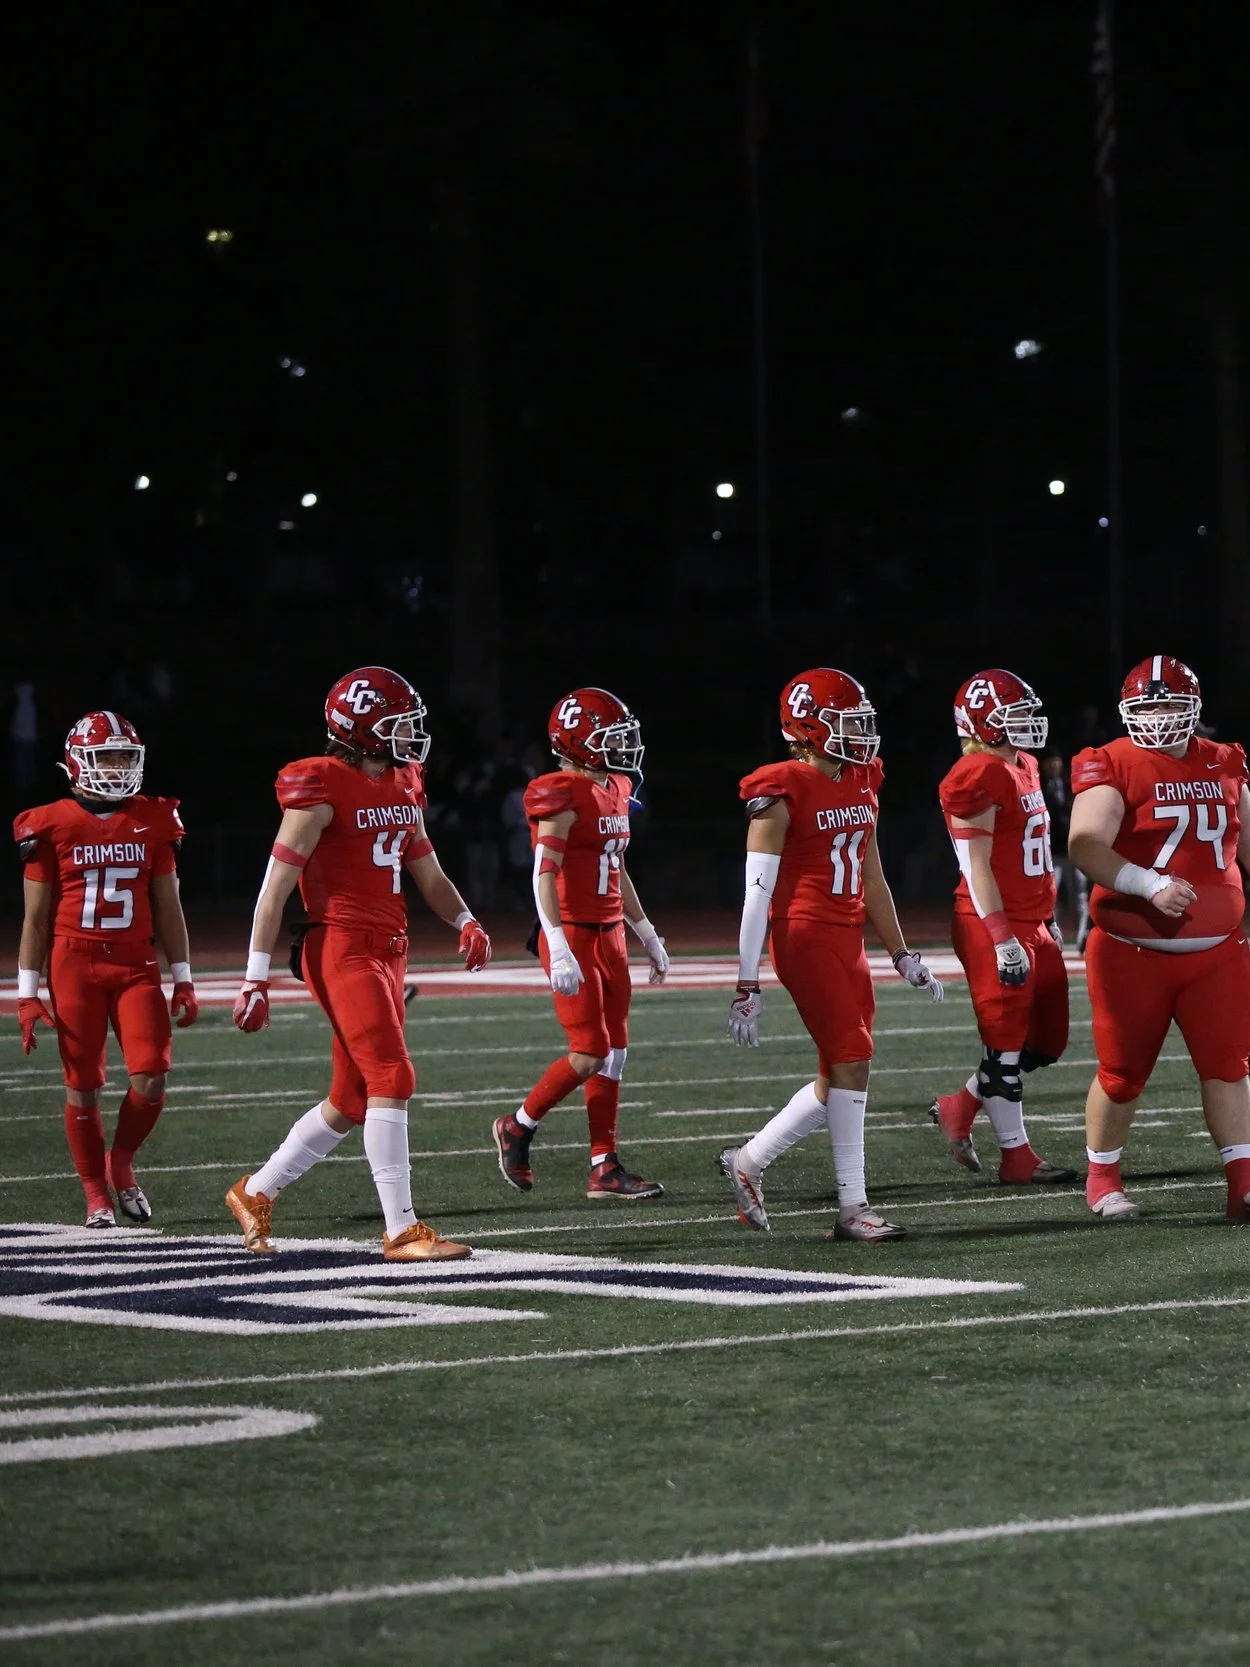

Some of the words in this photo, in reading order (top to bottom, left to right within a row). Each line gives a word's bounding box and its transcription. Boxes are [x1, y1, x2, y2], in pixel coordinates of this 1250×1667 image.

[346, 679, 376, 714] CC
[1155, 781, 1224, 801] CRIMSON
[356, 805, 419, 828] CRIMSON
[816, 804, 875, 830] CRIMSON
[73, 843, 146, 865] CRIMSON
[1152, 803, 1228, 870] 74
[372, 829, 408, 894] 4
[830, 829, 865, 895] 11
[81, 867, 140, 930] 15
